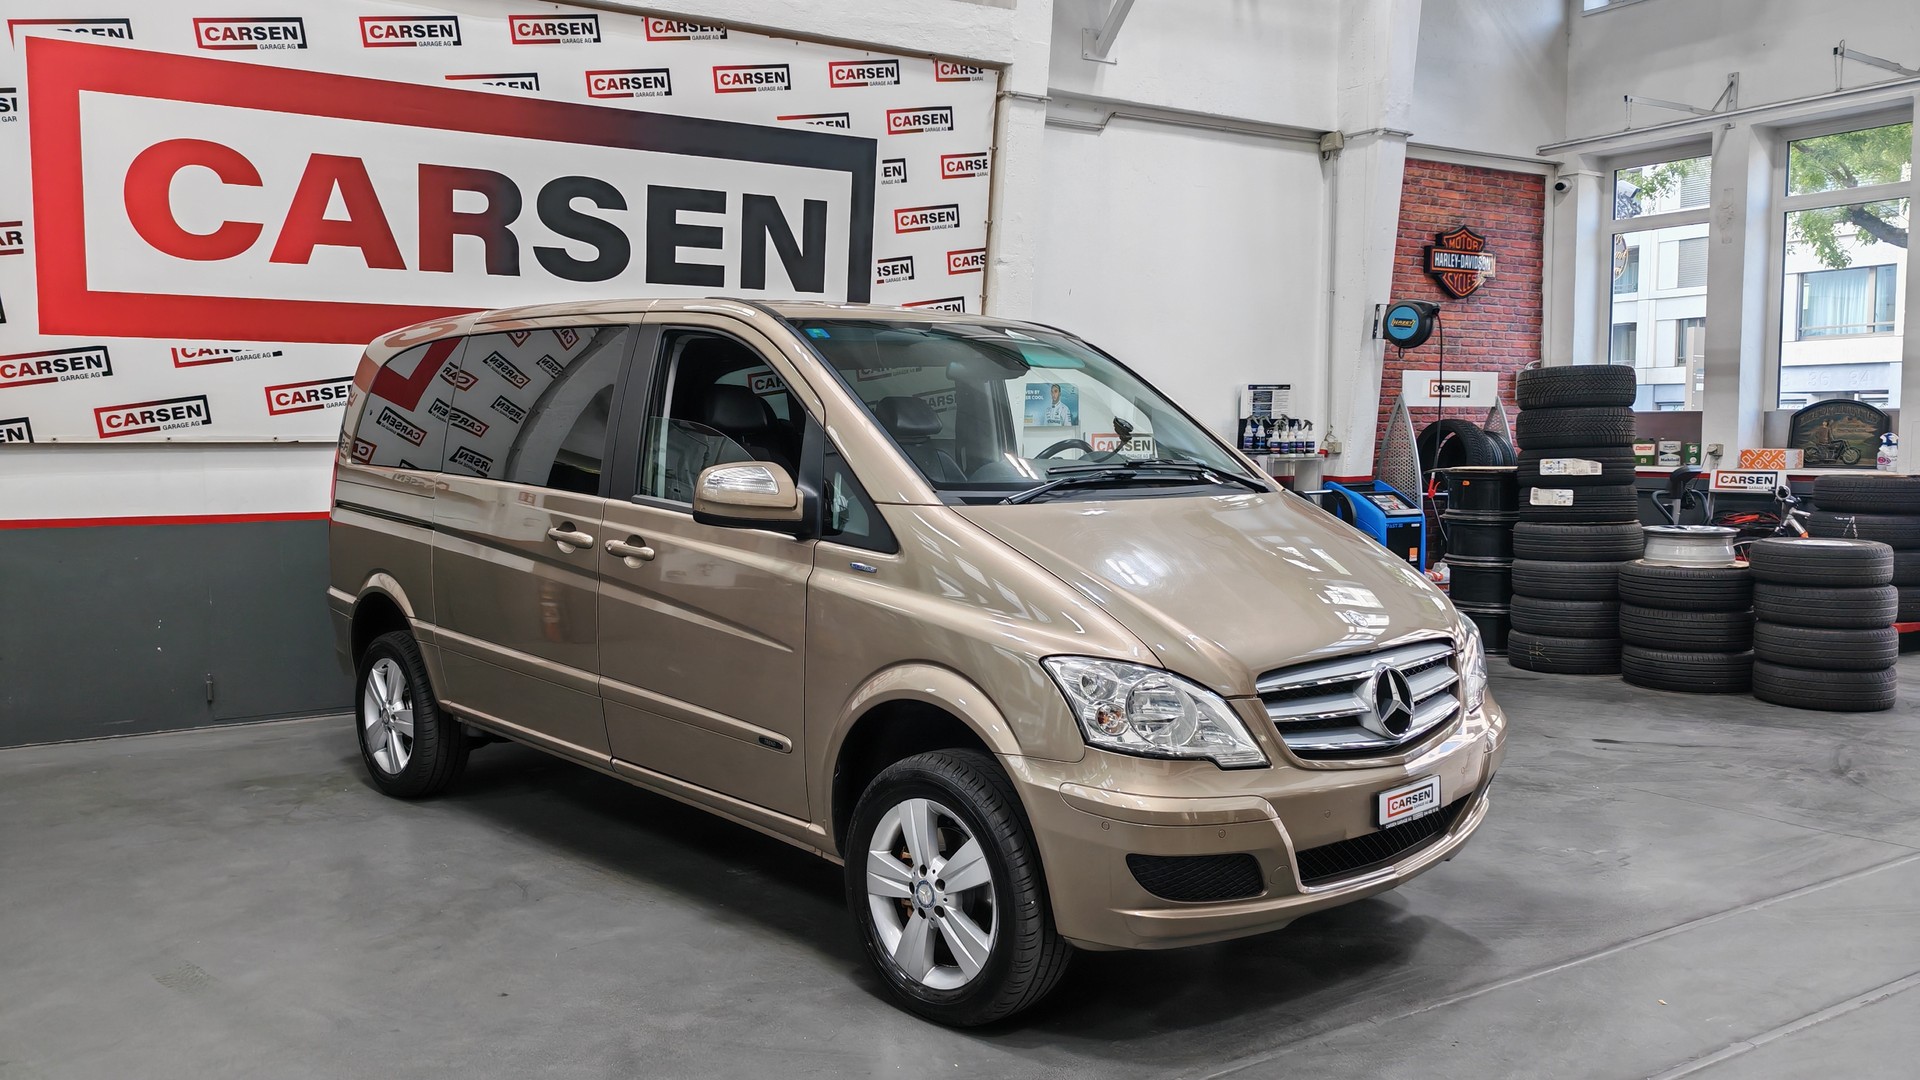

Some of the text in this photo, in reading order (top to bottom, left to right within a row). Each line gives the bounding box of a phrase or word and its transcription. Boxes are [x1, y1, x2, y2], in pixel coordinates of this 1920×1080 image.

[204, 26, 298, 41] CARSEN
[369, 24, 454, 39] CARSEN
[517, 22, 594, 36] CARSEN
[720, 71, 785, 86] CARSEN
[835, 67, 895, 81] CARSEN
[593, 76, 665, 91] CARSEN
[892, 113, 948, 128] CARSEN
[882, 165, 902, 177] EN
[124, 137, 827, 293] CARSEN
[900, 211, 955, 226] CARSEN
[1448, 234, 1479, 250] MOTOR
[1434, 252, 1491, 271] HARLEY-DAVIDSON
[1447, 273, 1478, 292] CYCLES
[235, 353, 261, 361] GARAGE
[1, 354, 103, 379] CARSEN
[60, 371, 101, 382] GARAGE AG
[1432, 385, 1468, 393] CRSEN
[106, 404, 202, 429] CARSEN
[162, 422, 190, 431] GARAGE
[1720, 475, 1773, 485] CARSEN
[1391, 789, 1431, 811] CARSEN
